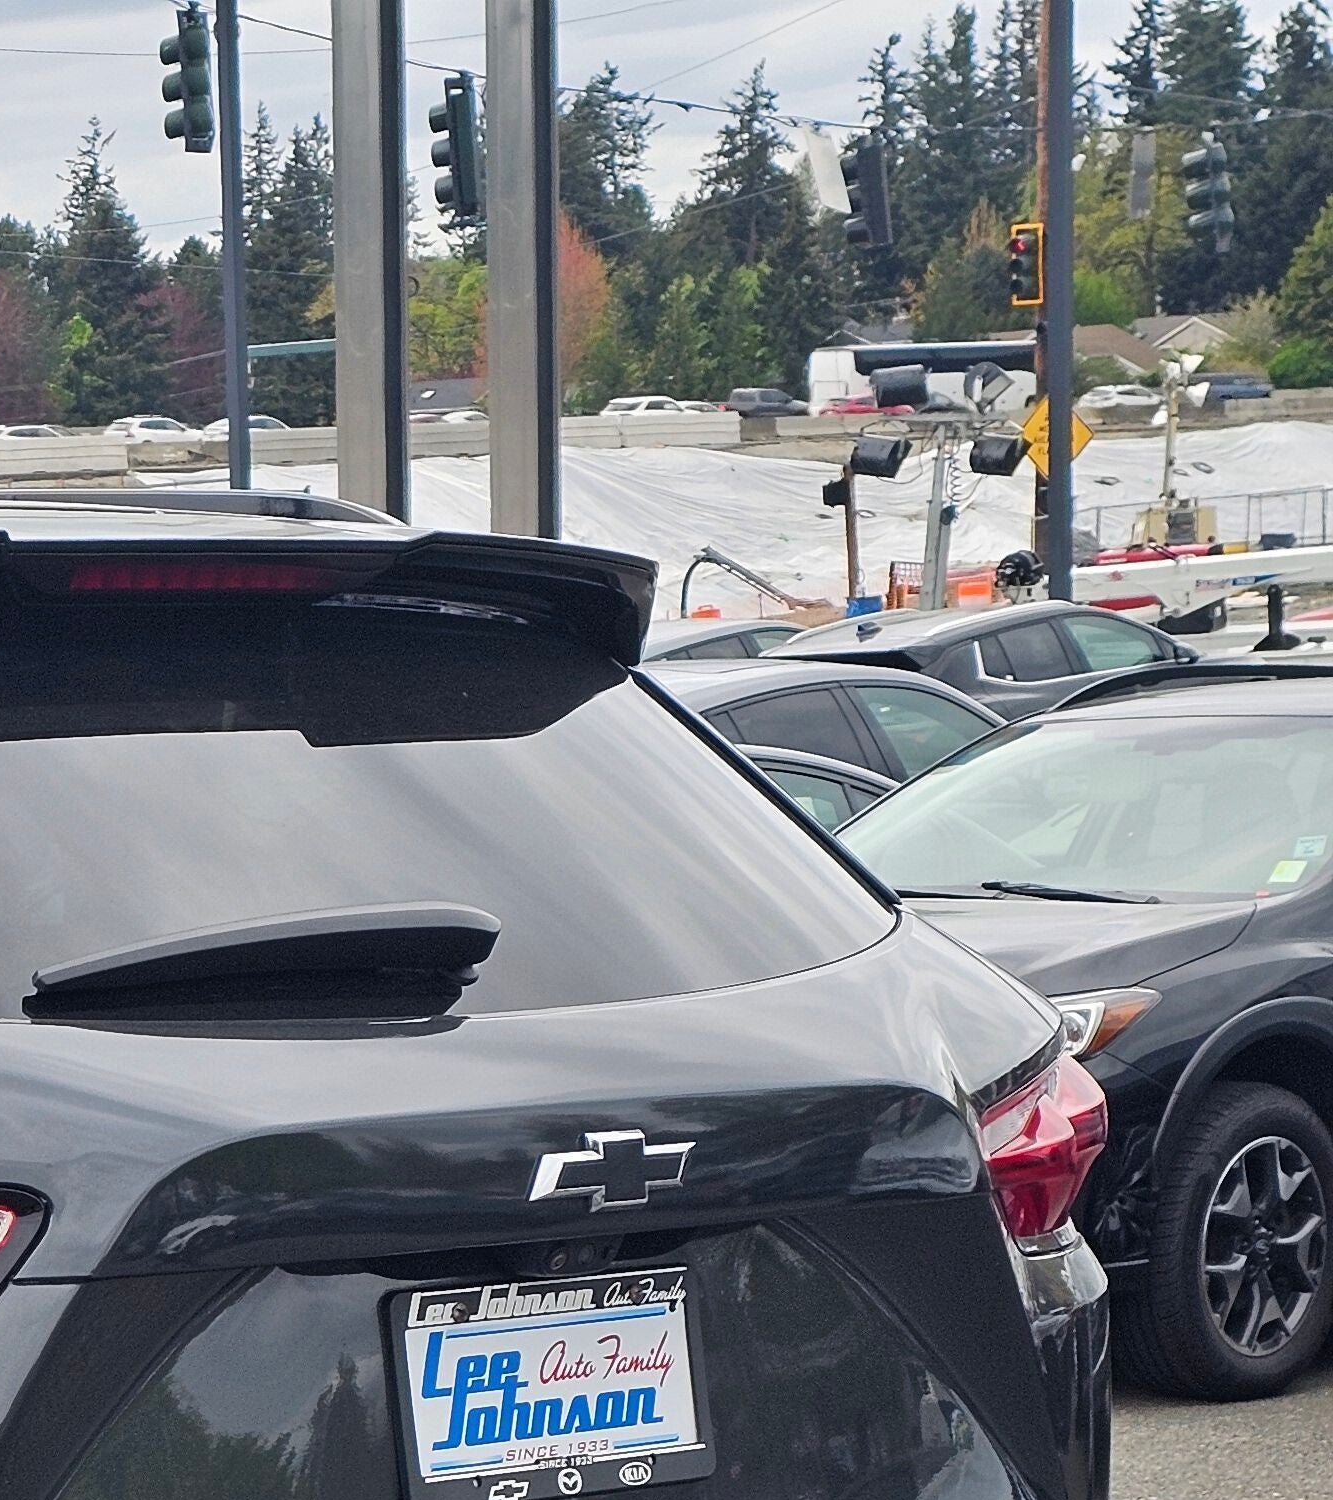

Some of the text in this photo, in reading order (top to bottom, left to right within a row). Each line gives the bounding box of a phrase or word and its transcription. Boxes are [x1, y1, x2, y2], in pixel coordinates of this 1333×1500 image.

[469, 1282, 597, 1321] Johnson
[603, 1281, 637, 1307] Aut
[638, 1275, 687, 1313] Family
[421, 1330, 676, 1399] Lee Auto Family
[431, 1383, 664, 1451] Johnson
[505, 1439, 610, 1462] SINCE 1933
[538, 1457, 567, 1470] SINCE
[622, 1464, 648, 1483] KIA
